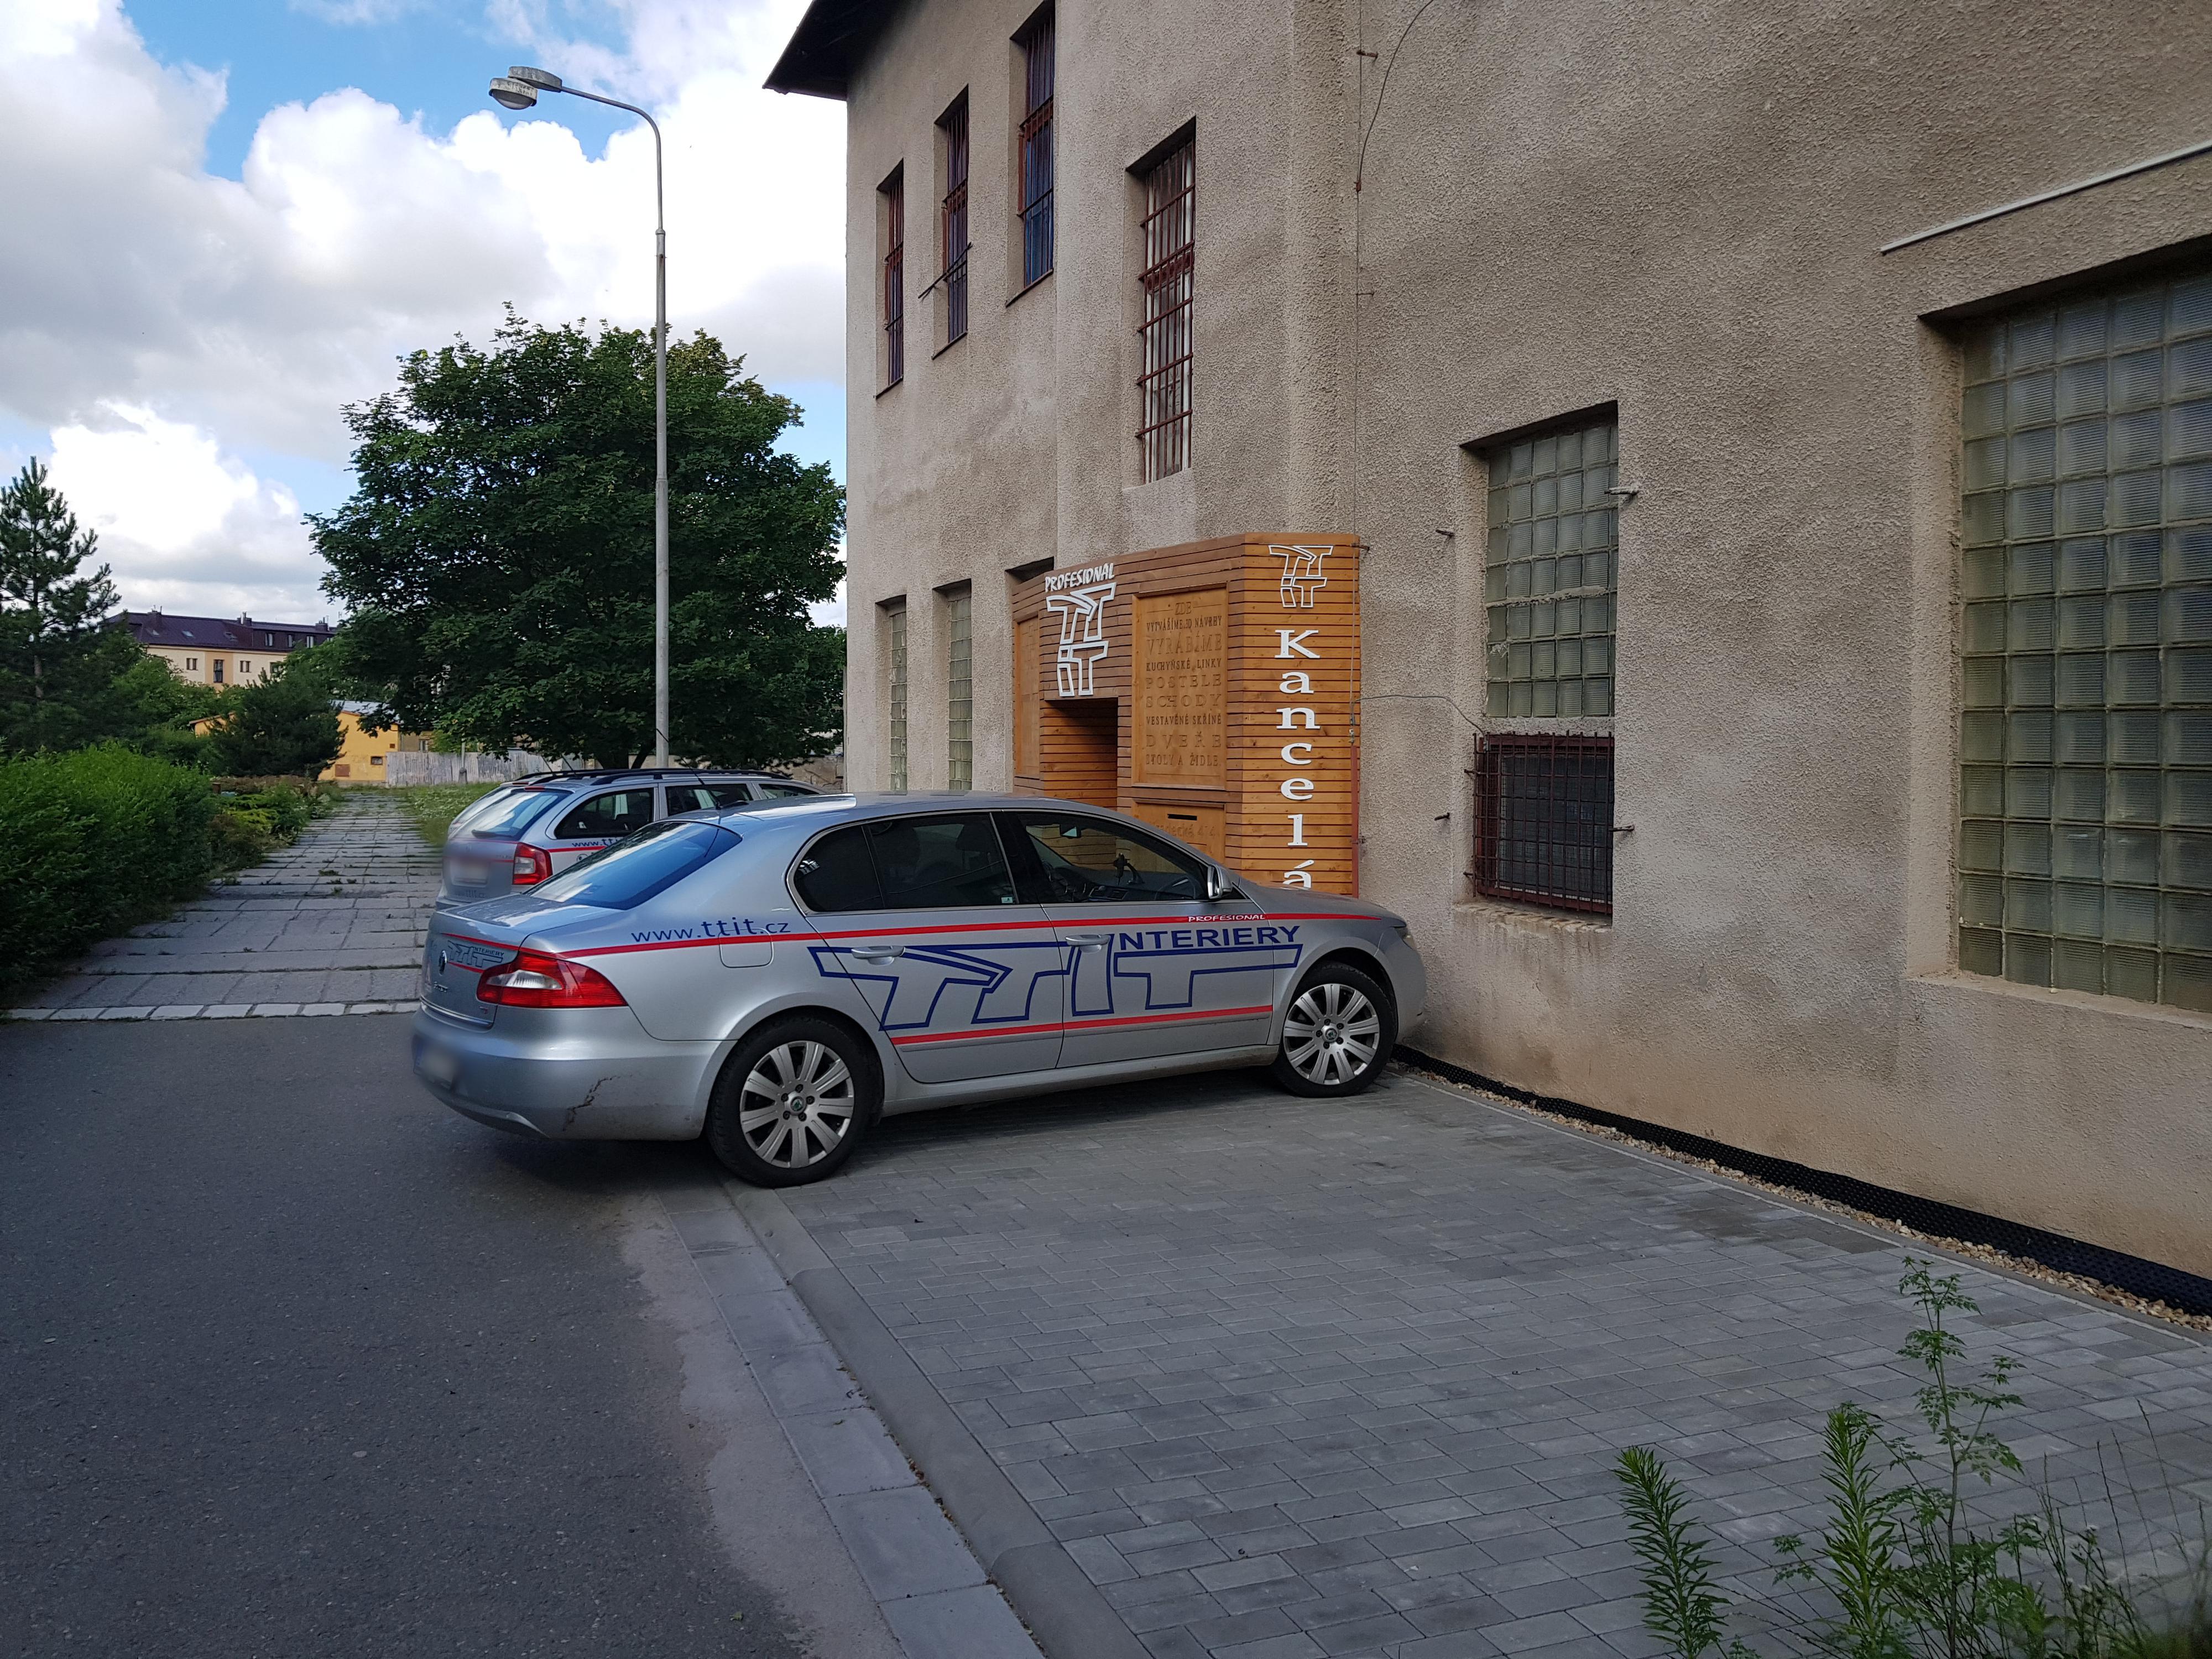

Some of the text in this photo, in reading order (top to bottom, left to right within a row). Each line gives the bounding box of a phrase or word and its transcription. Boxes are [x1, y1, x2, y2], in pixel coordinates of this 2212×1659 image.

[1045, 562, 1115, 593] PROFESIONAL
[1175, 601, 1192, 615] ZDE
[1194, 614, 1222, 628] NÁVRHY
[1197, 658, 1222, 669] LINKY
[1146, 674, 1222, 689] POSTELE
[1146, 694, 1222, 708] SCHODY
[1146, 731, 1222, 749] DVEŘE
[1146, 754, 1174, 765] STOLY
[1178, 754, 1183, 765] A
[1188, 914, 1266, 922] PROFESIONAL
[631, 917, 791, 942] www.ttit.cz
